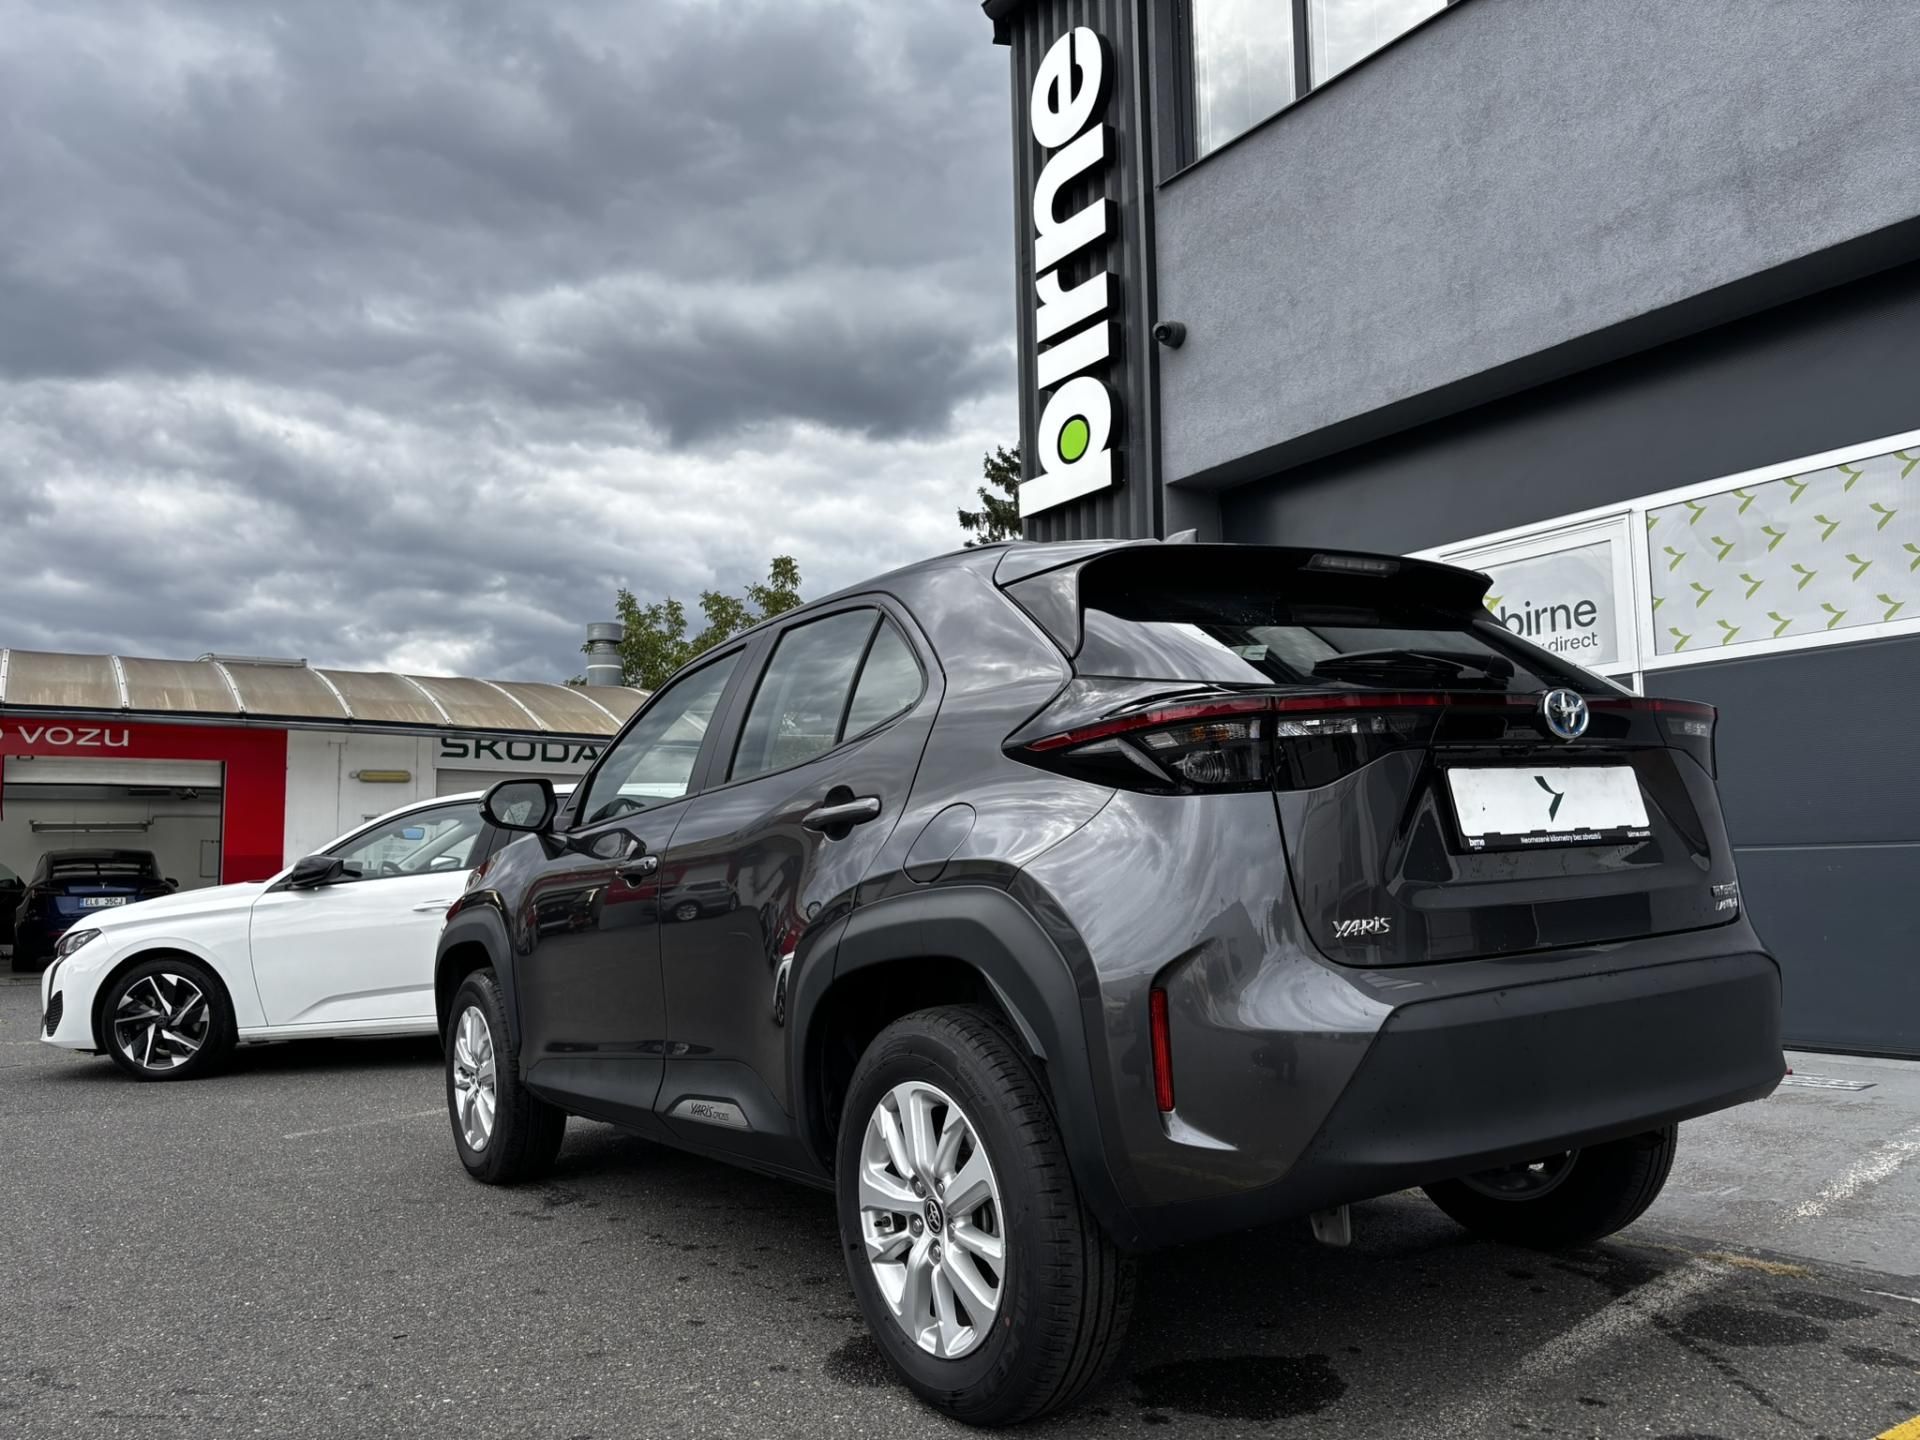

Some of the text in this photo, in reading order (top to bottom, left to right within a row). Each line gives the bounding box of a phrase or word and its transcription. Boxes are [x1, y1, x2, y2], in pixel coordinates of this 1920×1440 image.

[1019, 26, 1112, 518] birne
[1500, 599, 1597, 637] birne
[1548, 631, 1598, 652] direct
[1332, 916, 1392, 938] YARIS
[691, 1103, 714, 1118] YARIS
